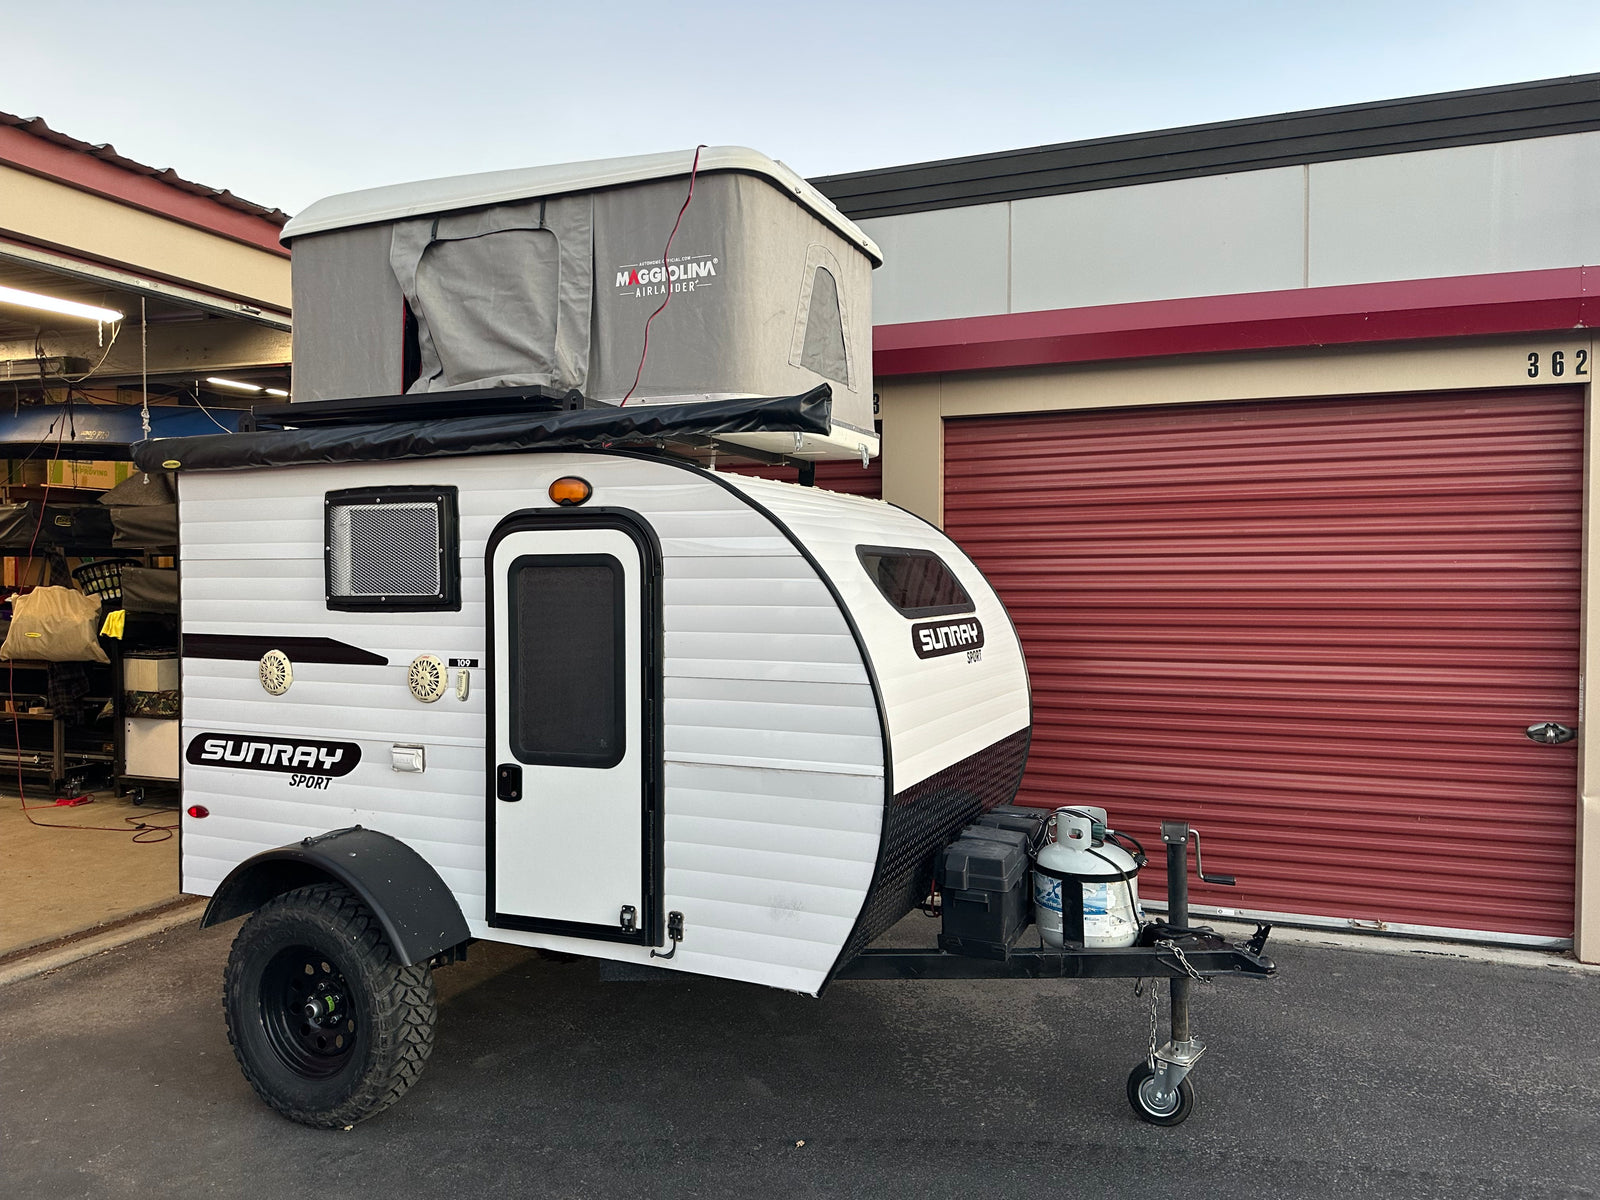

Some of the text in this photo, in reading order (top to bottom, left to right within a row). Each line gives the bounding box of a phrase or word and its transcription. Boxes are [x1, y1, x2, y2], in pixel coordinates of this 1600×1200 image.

[1527, 349, 1588, 378] 362
[918, 623, 978, 652] SUNRAY
[457, 659, 471, 667] 109
[201, 739, 344, 770] SUNRAY
[289, 774, 333, 790] SPORT
